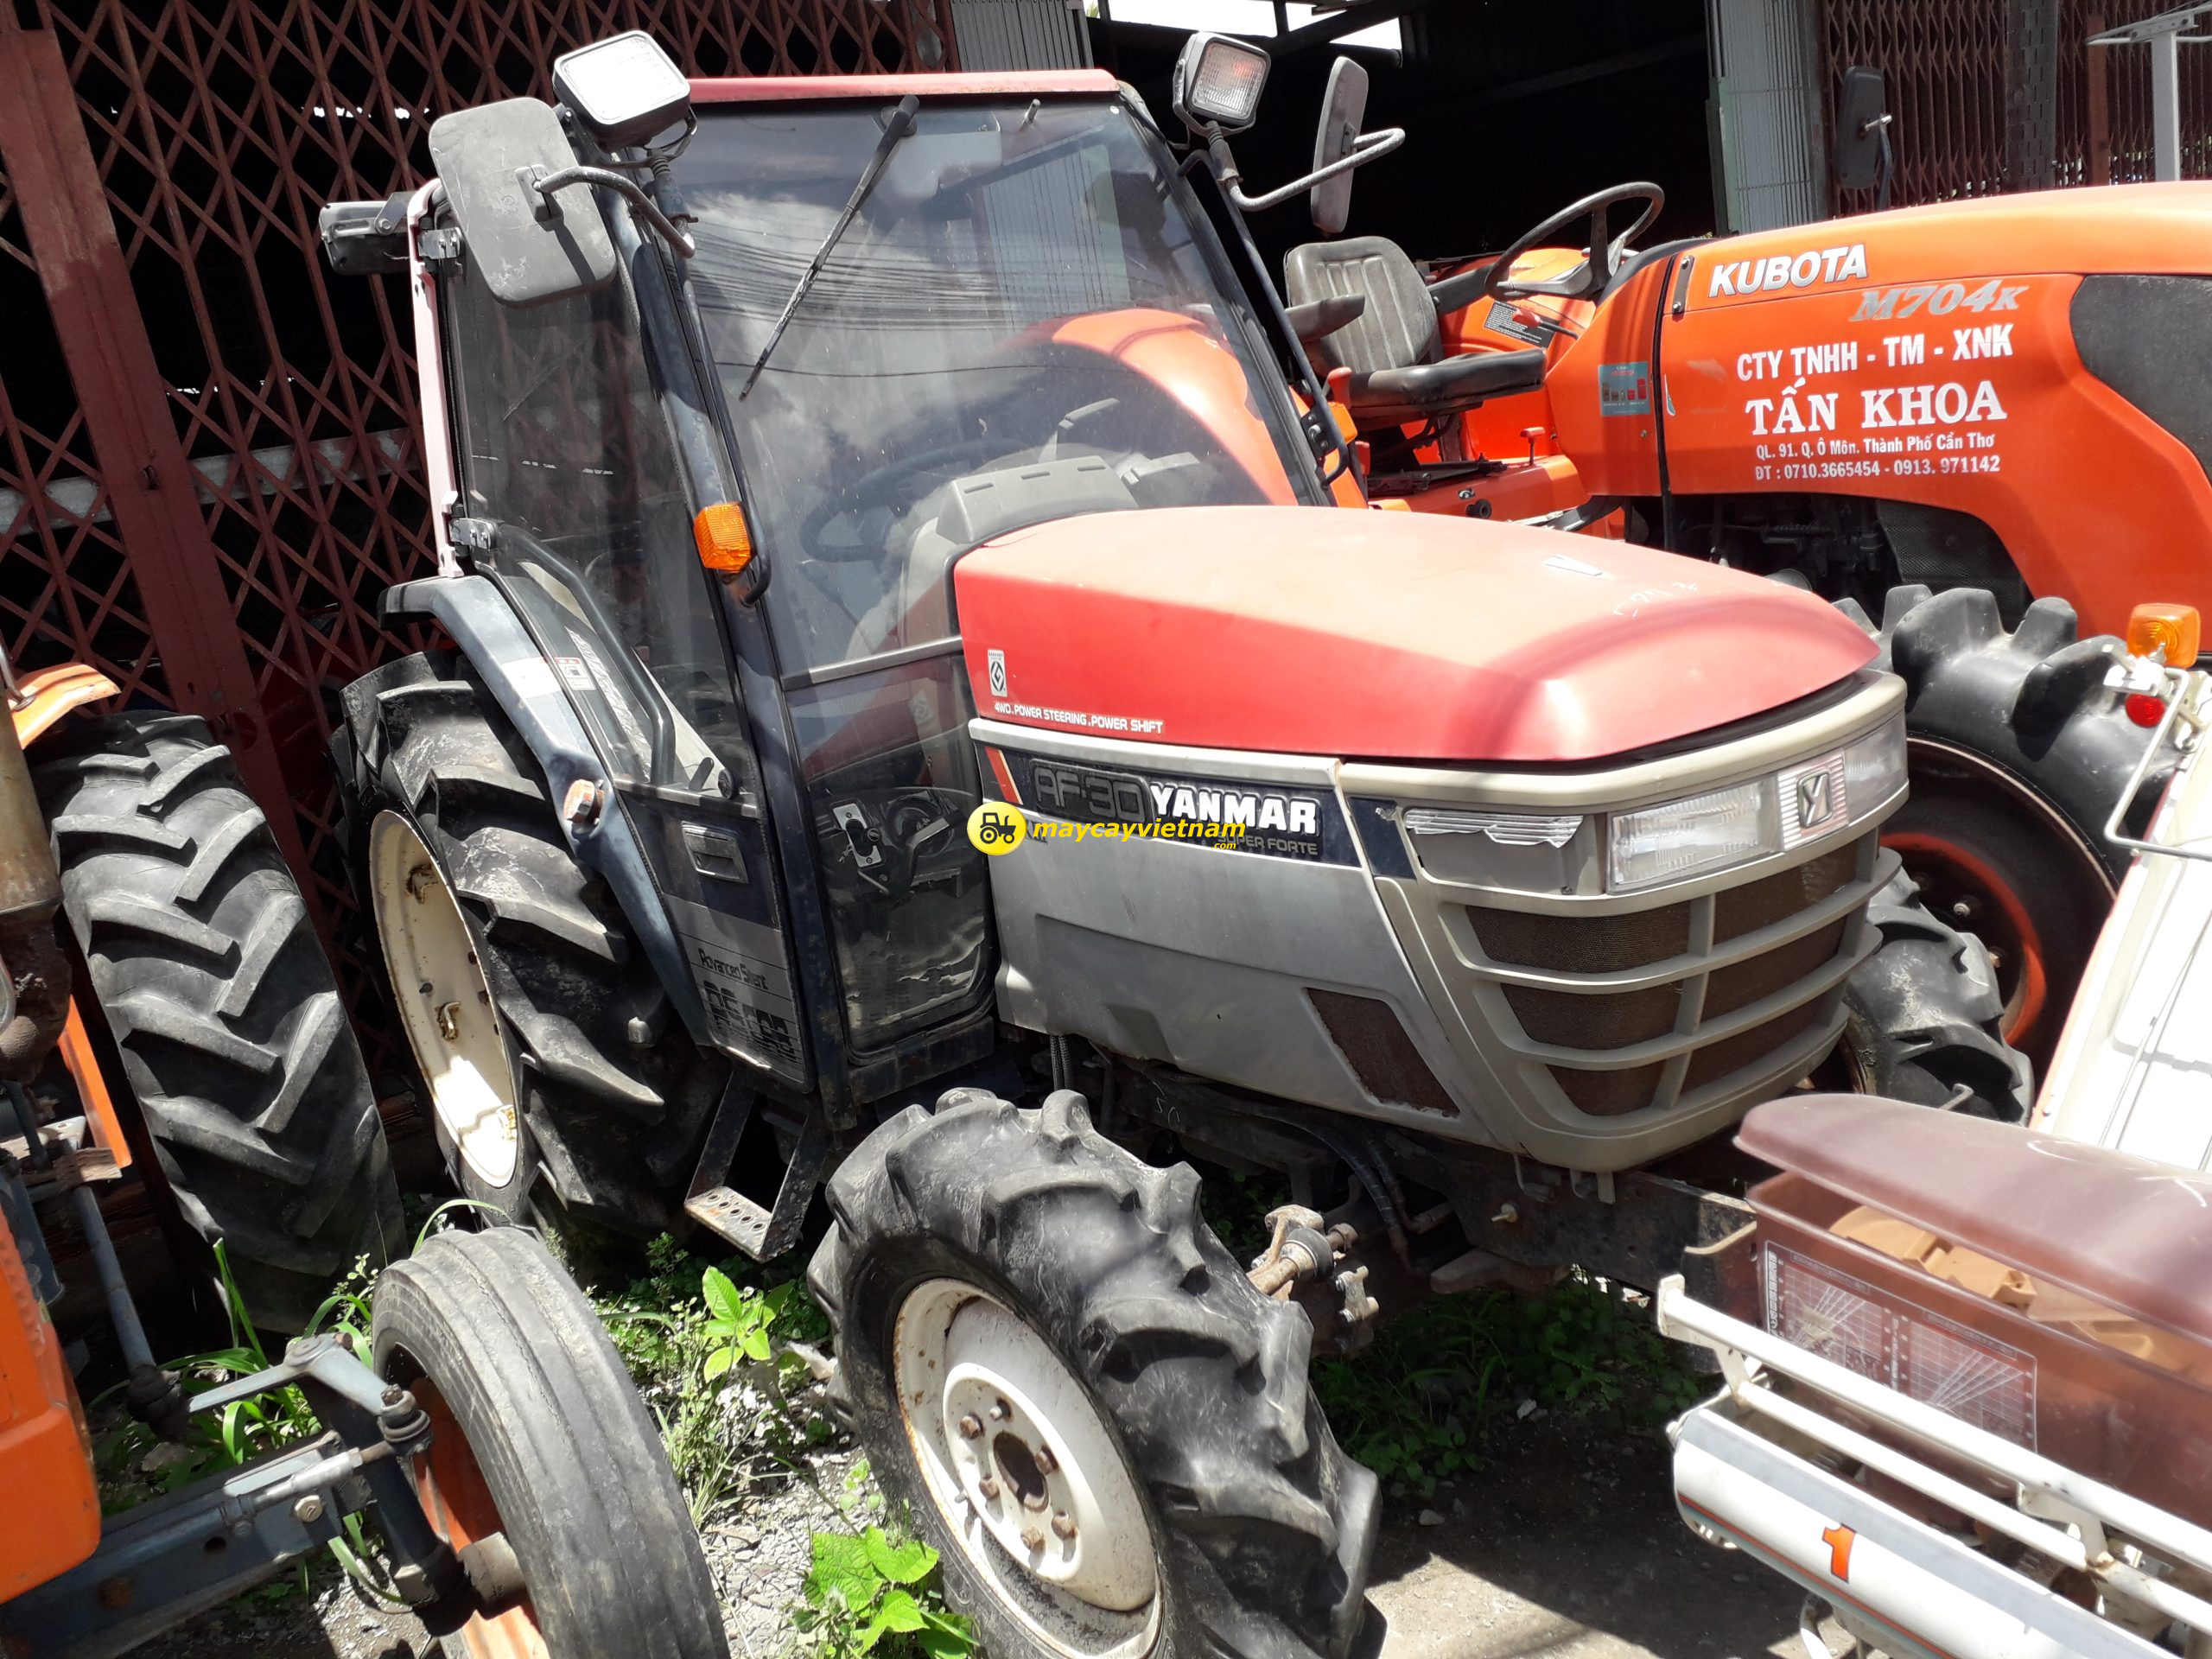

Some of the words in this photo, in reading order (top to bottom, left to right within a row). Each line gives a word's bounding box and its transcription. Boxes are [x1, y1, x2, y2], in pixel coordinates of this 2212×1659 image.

[1708, 244, 1867, 298] KUBOTA
[1849, 280, 2030, 321] M704K
[1737, 349, 1783, 381] CTY
[1790, 341, 1858, 376] TNHH
[1883, 334, 1925, 366] TM
[1953, 323, 2014, 361] XNK
[1745, 377, 1839, 435] TẤN
[1861, 380, 2007, 429] KHOA
[1756, 466, 1771, 480] ĐT
[1784, 461, 1880, 480] 0710.3665454
[1940, 455, 2000, 474] 971142
[1758, 444, 1776, 461] QL.
[1778, 442, 1798, 458] 91.
[1817, 437, 1826, 456] Ô
[1863, 437, 1903, 454] Thành
[1907, 433, 1934, 451] Phố
[1936, 432, 1963, 450] Cần
[1967, 432, 1995, 448] Thơ
[1130, 720, 1164, 734] SHIFT
[1150, 783, 1317, 834] YANMAR
[1268, 837, 1319, 855] FORTE
[1821, 1522, 1857, 1584] 1
